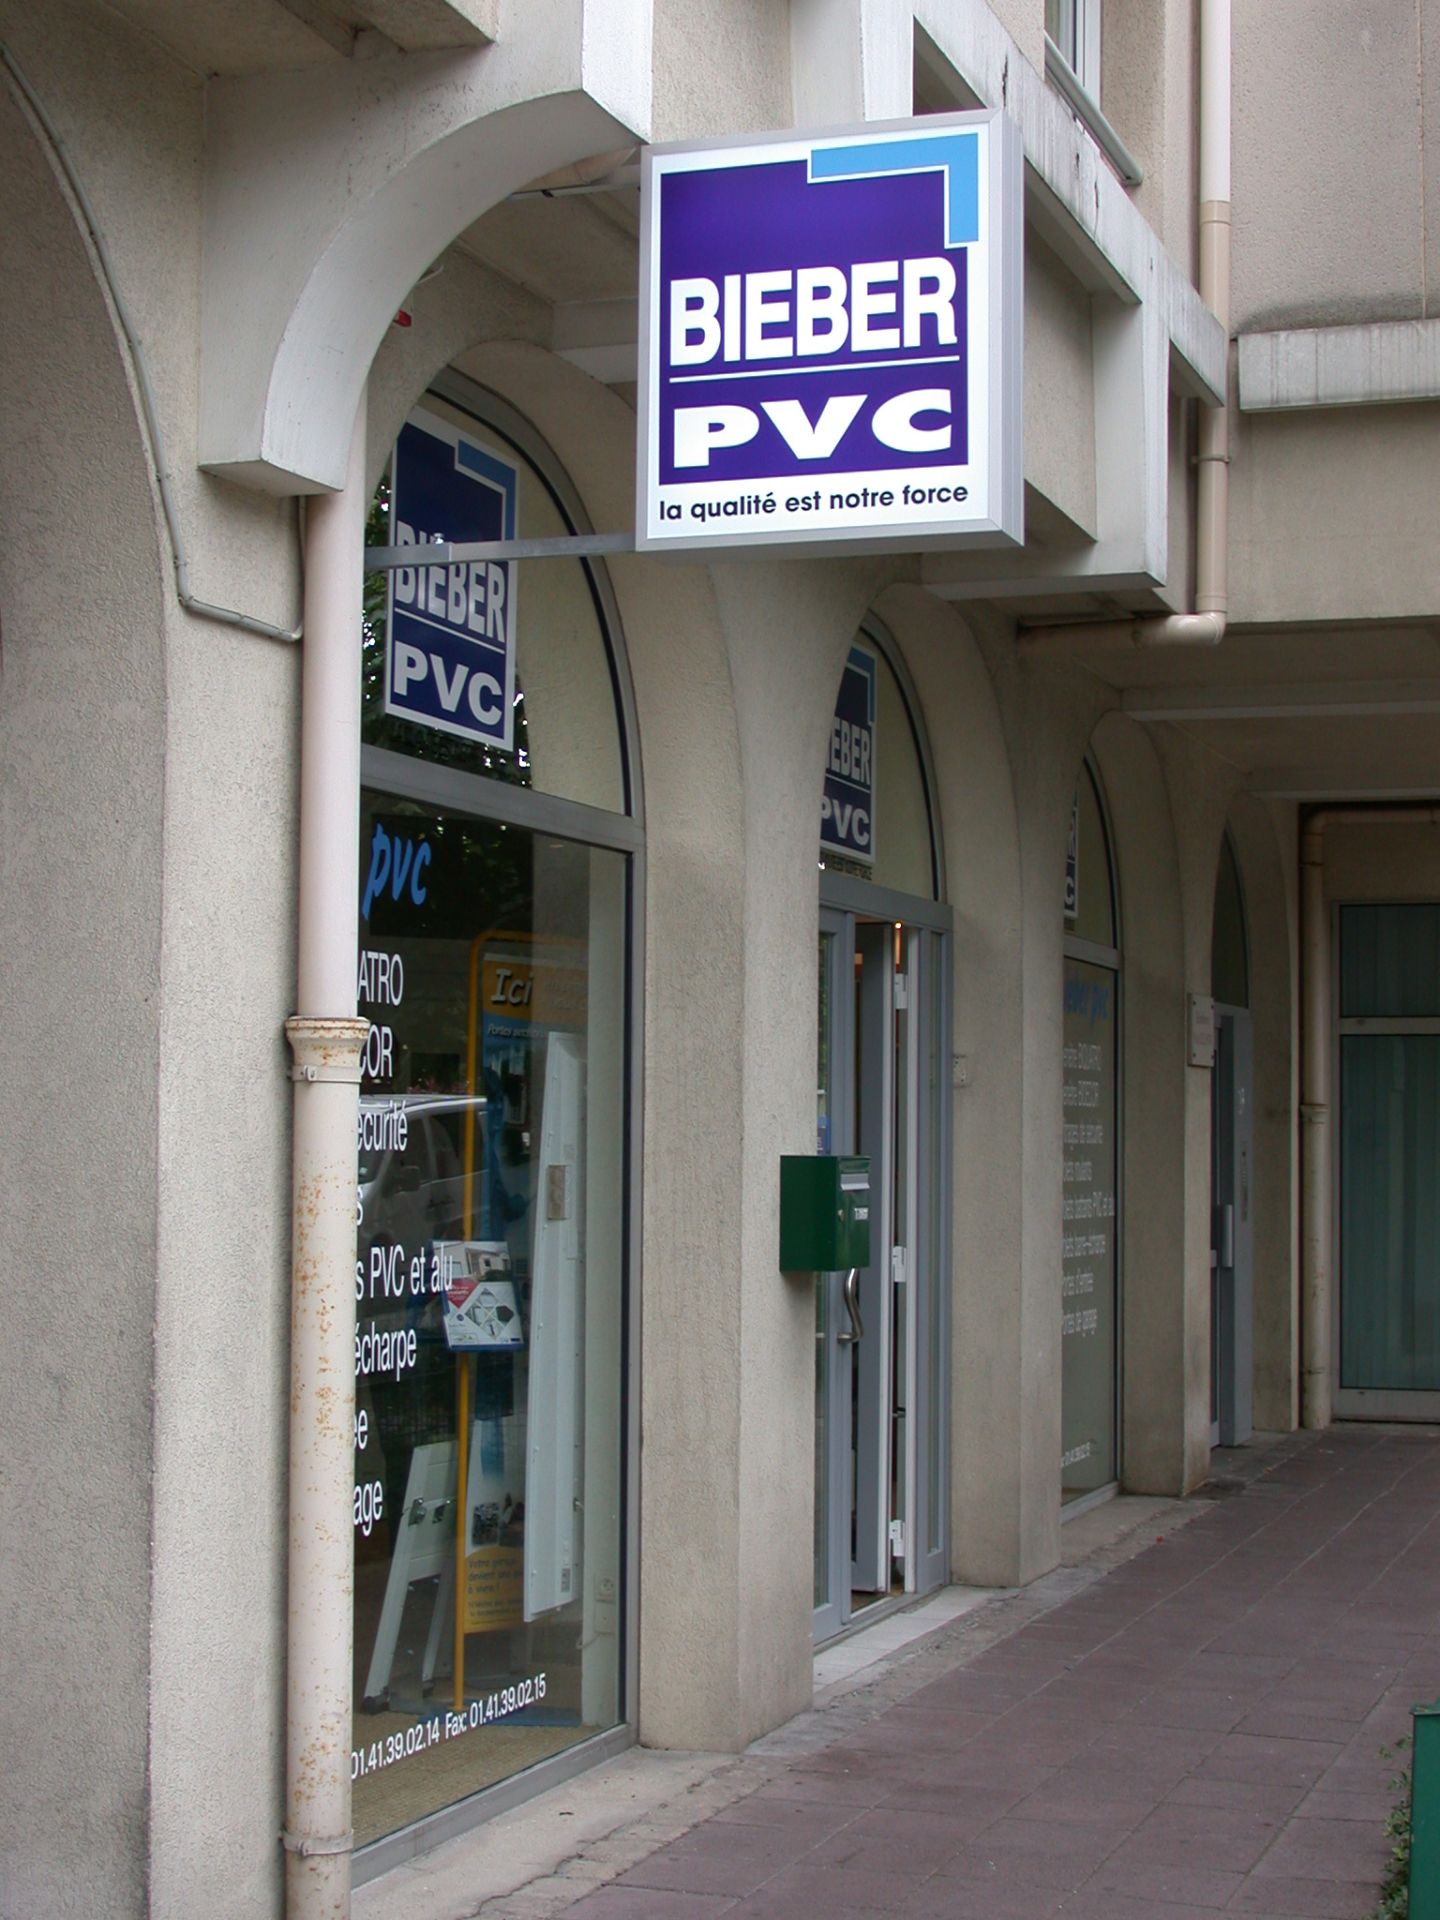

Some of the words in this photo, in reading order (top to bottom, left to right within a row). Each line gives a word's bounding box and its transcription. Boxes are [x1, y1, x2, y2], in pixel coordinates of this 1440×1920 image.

[669, 256, 958, 366] BIEBER
[673, 388, 953, 469] PVC
[659, 499, 682, 520] la
[691, 491, 777, 522] qualité
[785, 490, 821, 512] est
[829, 484, 895, 510] notre
[902, 483, 968, 507] force
[393, 639, 503, 726] PVC
[362, 823, 432, 921] pvc
[358, 949, 404, 1006] ATRO
[490, 967, 535, 1005] Ici
[370, 1244, 405, 1299] PVC
[410, 1246, 426, 1296] et
[431, 1243, 453, 1294] alu
[445, 1711, 468, 1740] Fax:
[469, 1673, 547, 1728] 01.41.39.02.15
